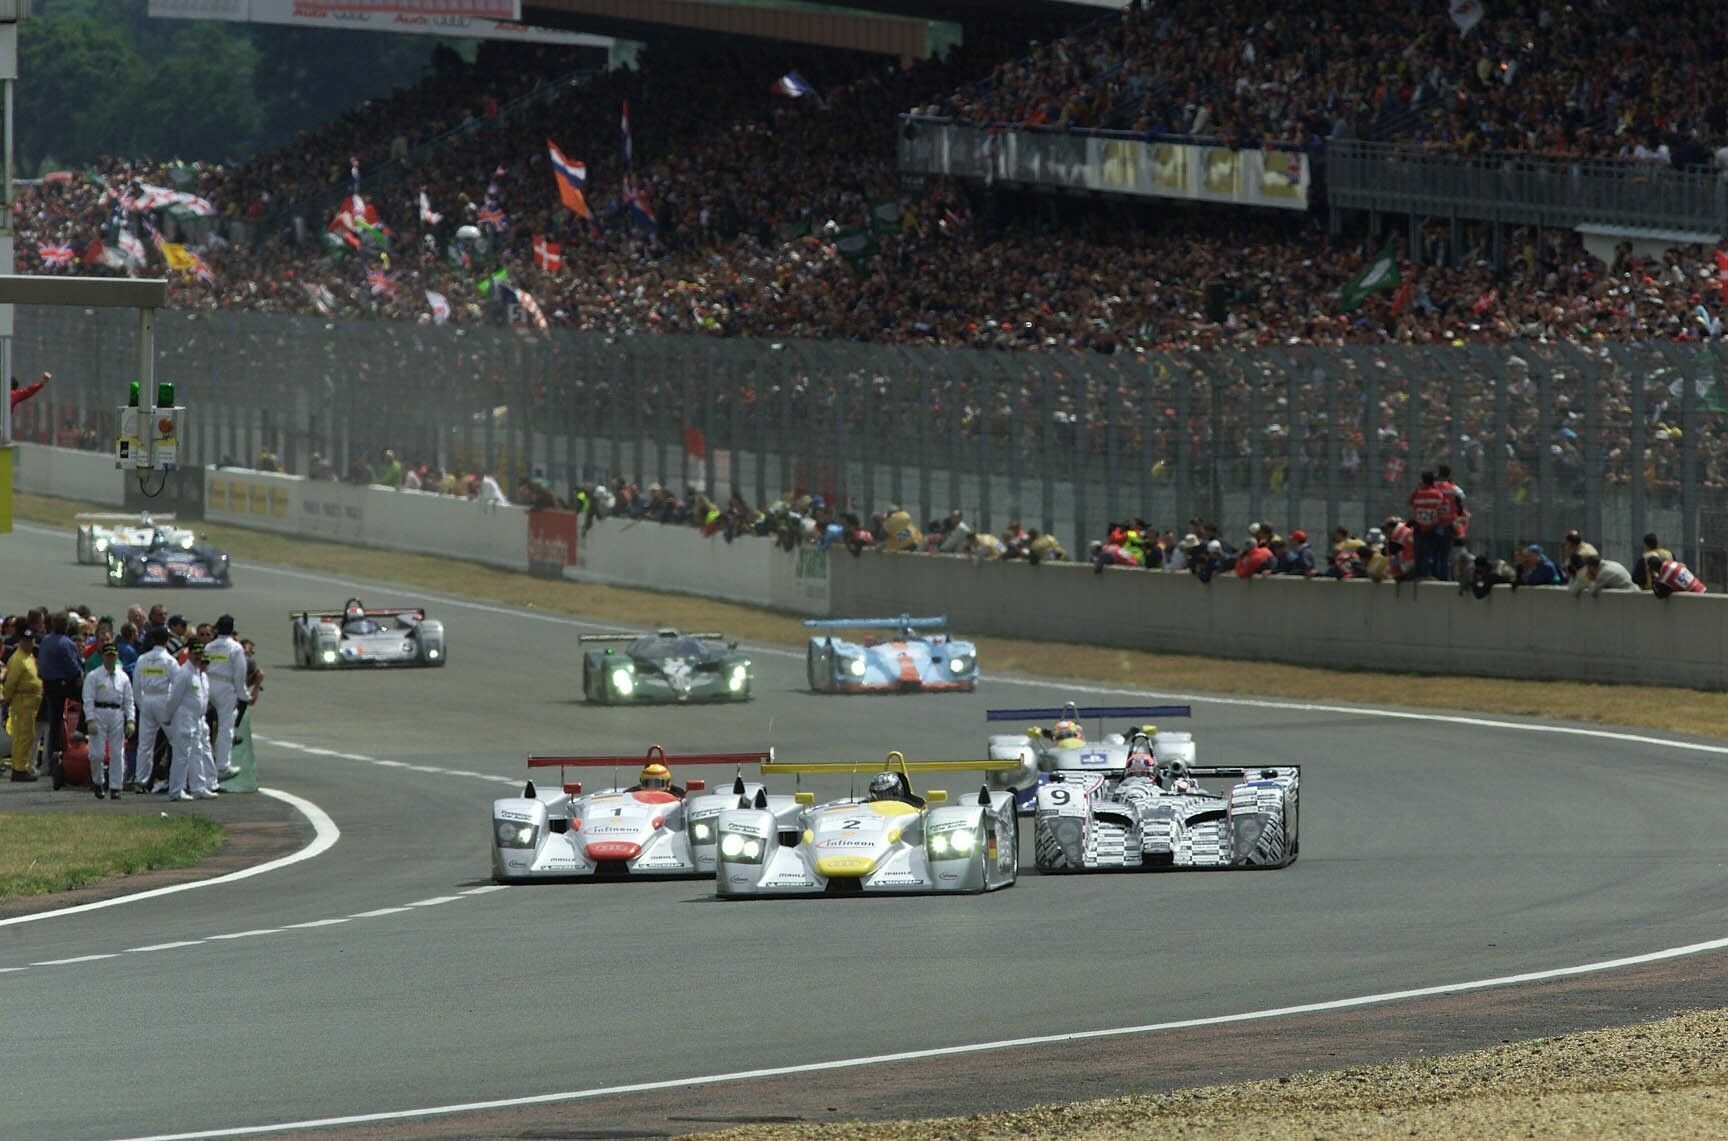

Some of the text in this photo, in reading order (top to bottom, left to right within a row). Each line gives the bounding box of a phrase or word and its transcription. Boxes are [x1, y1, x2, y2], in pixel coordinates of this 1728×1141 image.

[394, 13, 428, 25] Audi
[1051, 787, 1071, 806] 9
[609, 807, 622, 816] 1
[841, 819, 862, 830] 2
